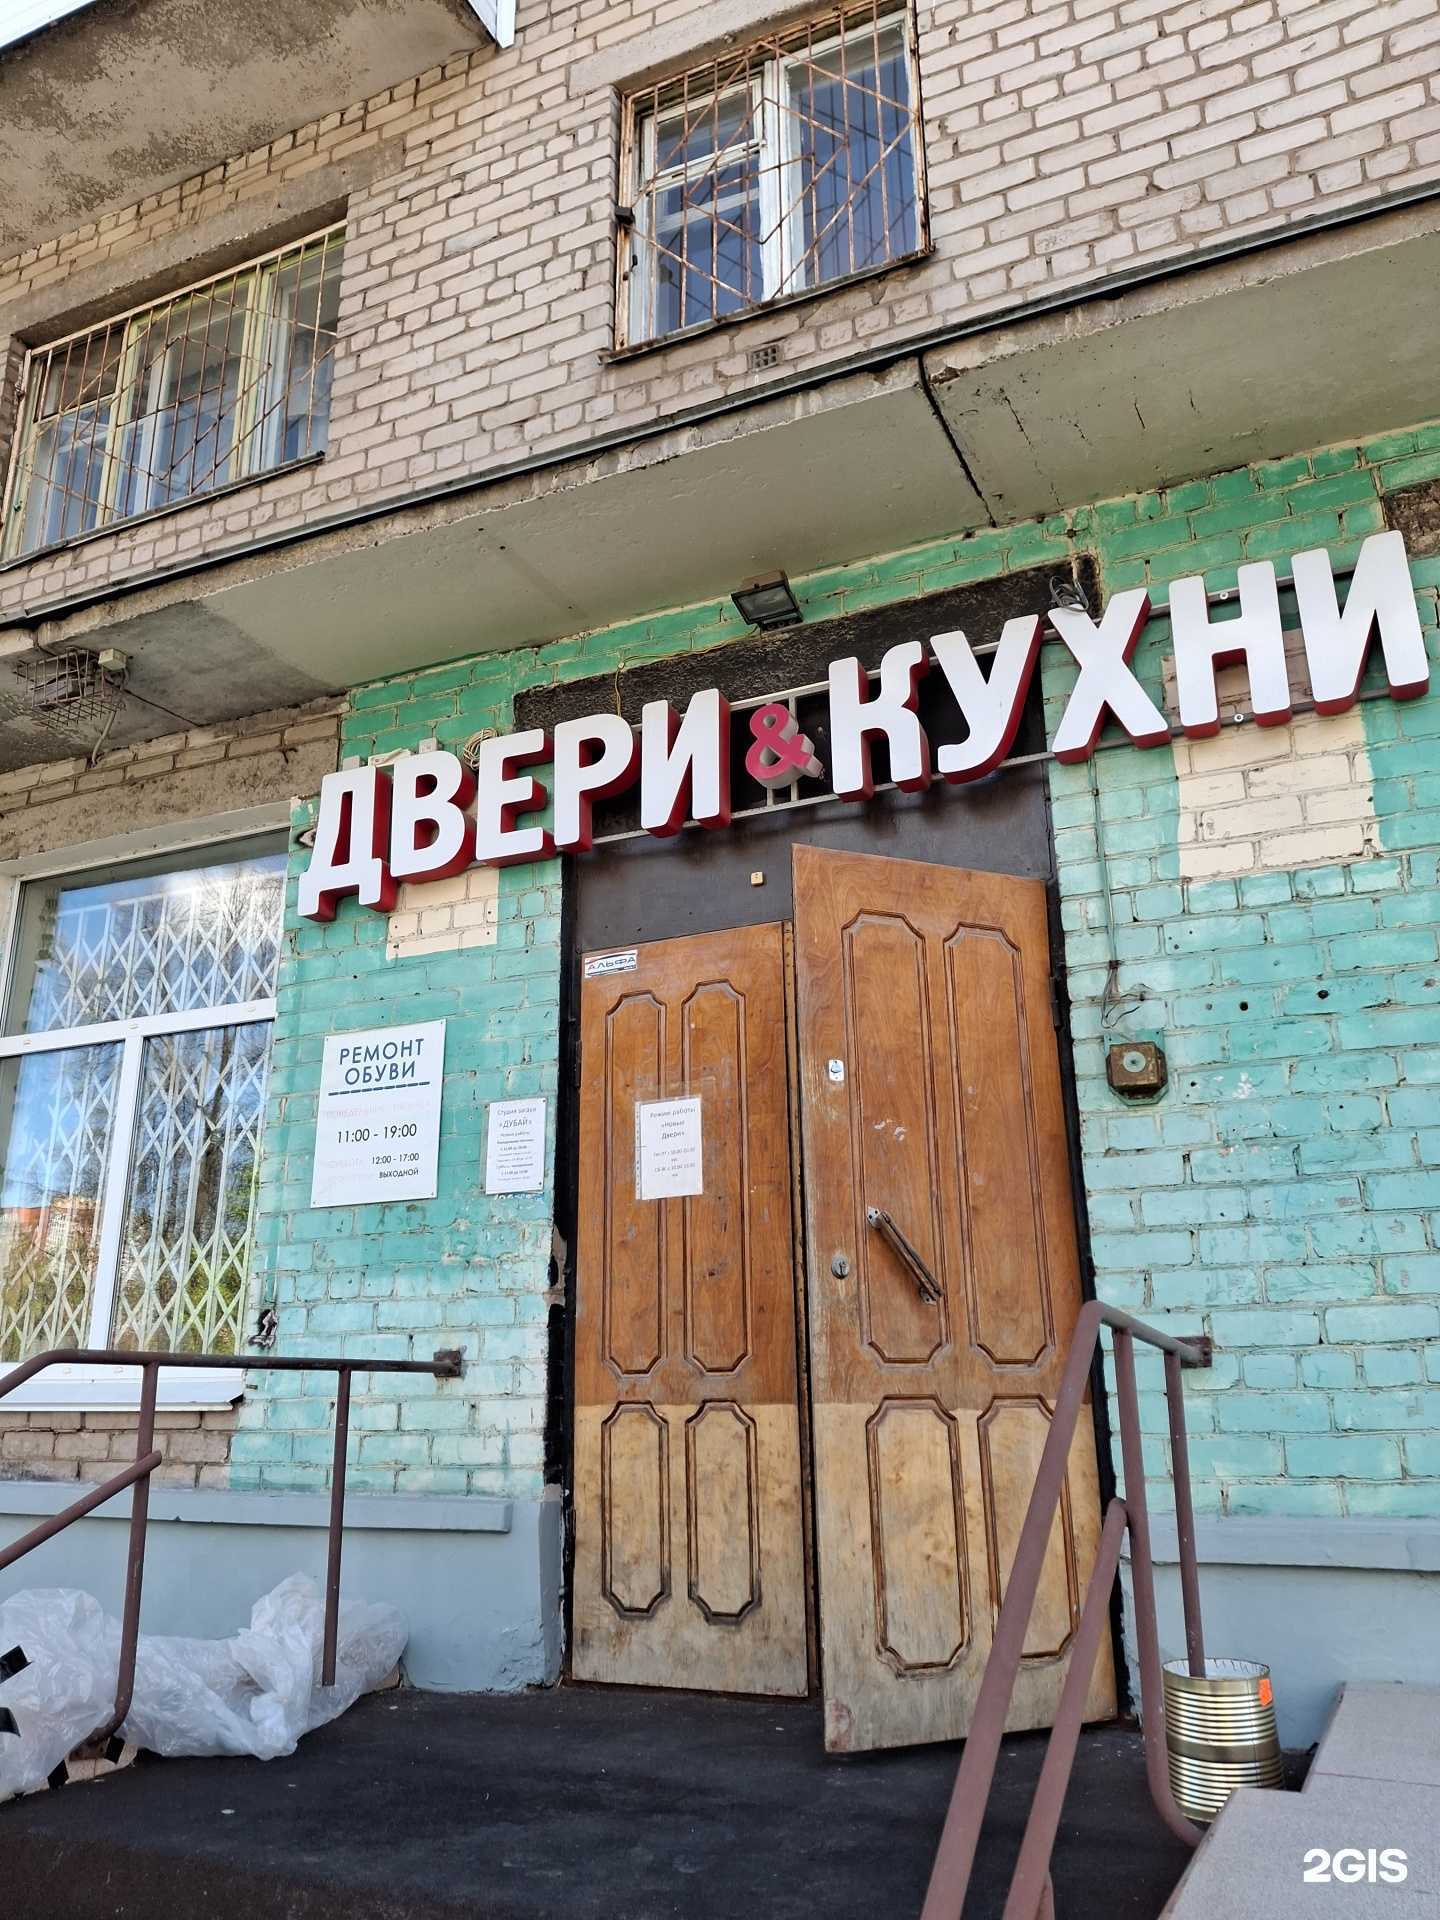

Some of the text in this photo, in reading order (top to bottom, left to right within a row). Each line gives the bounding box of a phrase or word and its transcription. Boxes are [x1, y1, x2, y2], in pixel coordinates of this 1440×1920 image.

[298, 530, 1430, 921] ДВЕРИ & КУХНИ
[588, 957, 635, 969] АЛЬФА
[339, 1038, 424, 1065] РЕМОНТ
[344, 1061, 415, 1085] ОБУВИ
[337, 1128, 370, 1144] 11:00
[383, 1123, 417, 1140] 19:00
[371, 1154, 392, 1165] 12:00
[399, 1152, 420, 1163] 17:00
[379, 1167, 419, 1179] ВЫХОДНОЙ
